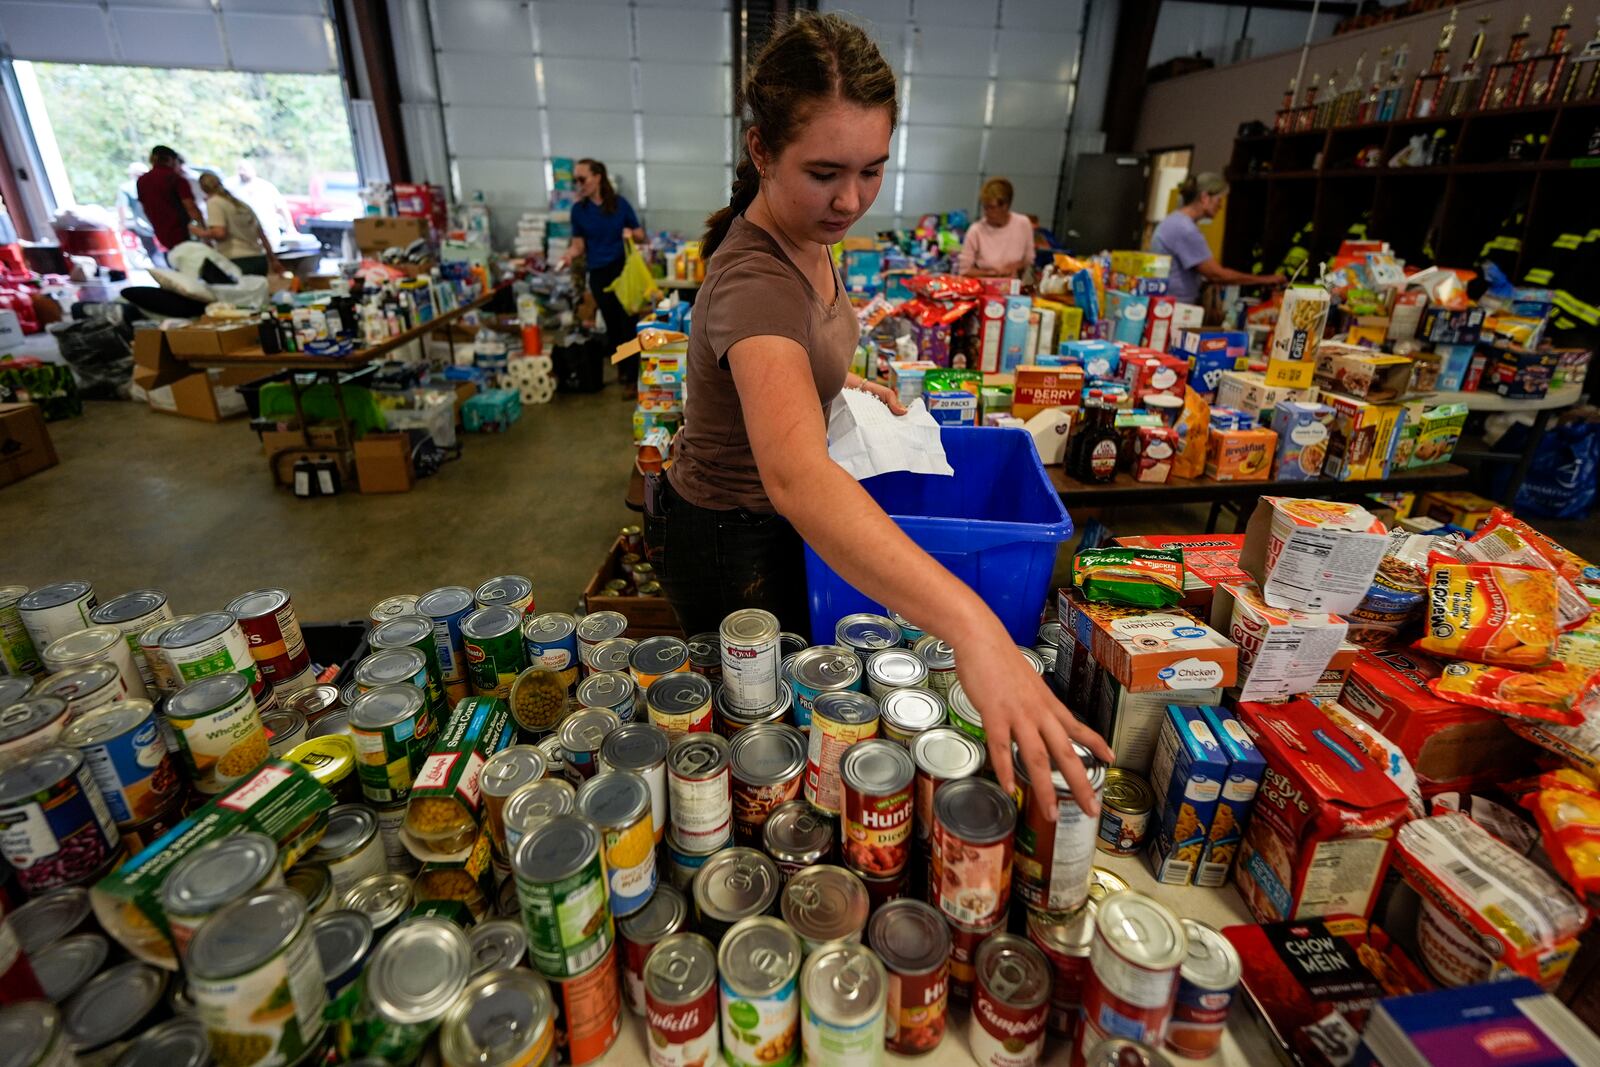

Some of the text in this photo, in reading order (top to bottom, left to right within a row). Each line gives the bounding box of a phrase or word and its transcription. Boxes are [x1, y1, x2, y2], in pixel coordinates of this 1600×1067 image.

[1034, 389, 1076, 399] BERRY
[1313, 549, 1330, 557] 290
[1431, 570, 1450, 629] Maruchan
[1353, 609, 1381, 620] VORY
[1487, 593, 1505, 627] Chicken
[1122, 620, 1176, 630] Chicken
[541, 653, 565, 661] Chicken
[730, 649, 753, 658] ROYAL
[1178, 669, 1217, 677] Chicken
[207, 721, 240, 741] Whole
[233, 722, 255, 739] Corn
[447, 701, 477, 748] Sweet Corn
[496, 711, 509, 732] Corn
[1260, 780, 1287, 810] kes
[1265, 767, 1310, 814] estyle
[1285, 937, 1335, 956] CHOW
[1296, 951, 1352, 975] MEIN
